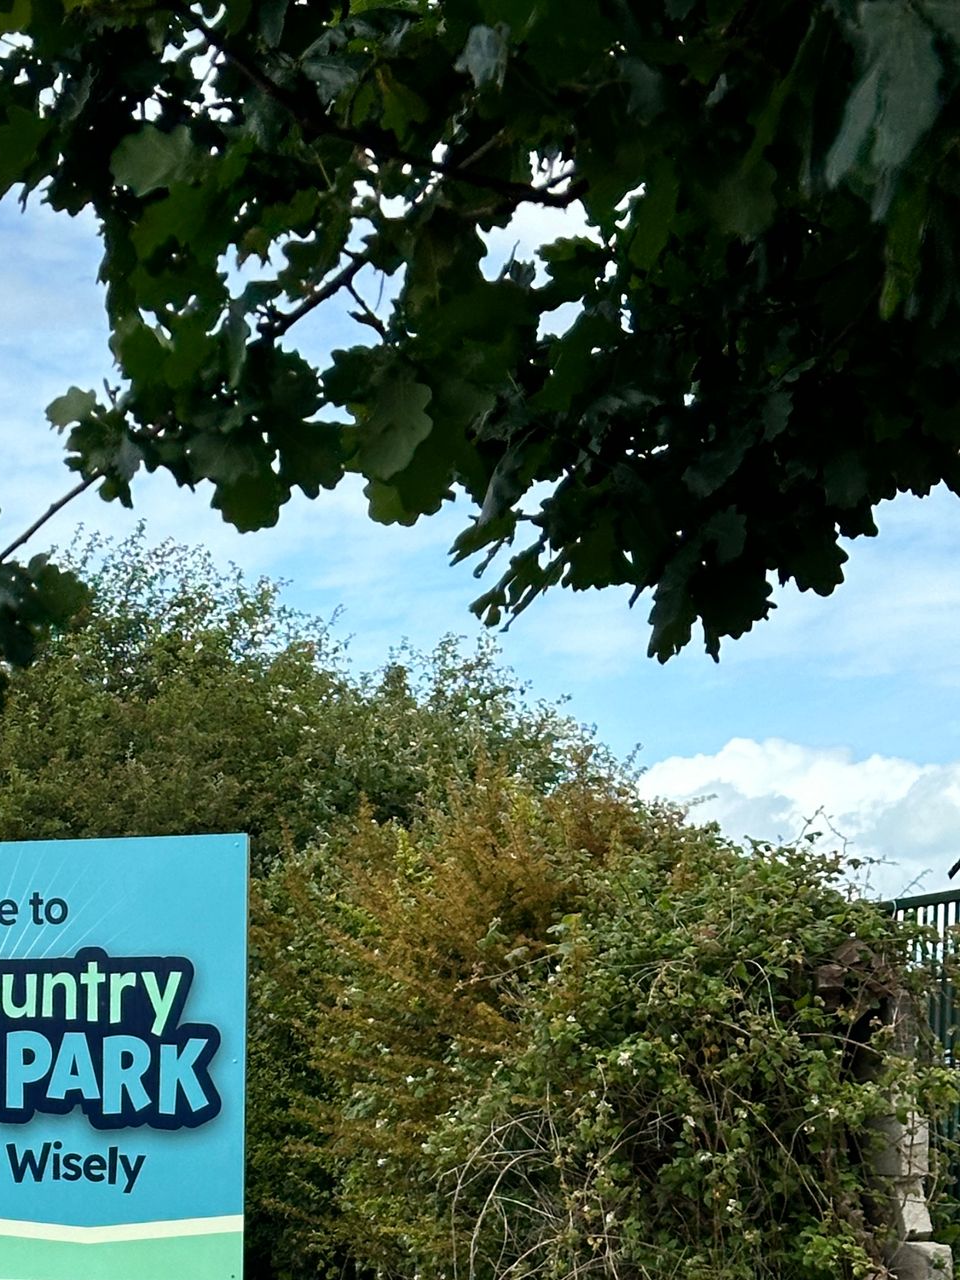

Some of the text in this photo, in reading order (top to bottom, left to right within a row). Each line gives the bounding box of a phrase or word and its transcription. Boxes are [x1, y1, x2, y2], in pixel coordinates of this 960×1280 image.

[29, 891, 69, 926] to
[6, 1031, 209, 1114] PARK
[6, 1141, 146, 1193] Wisely
